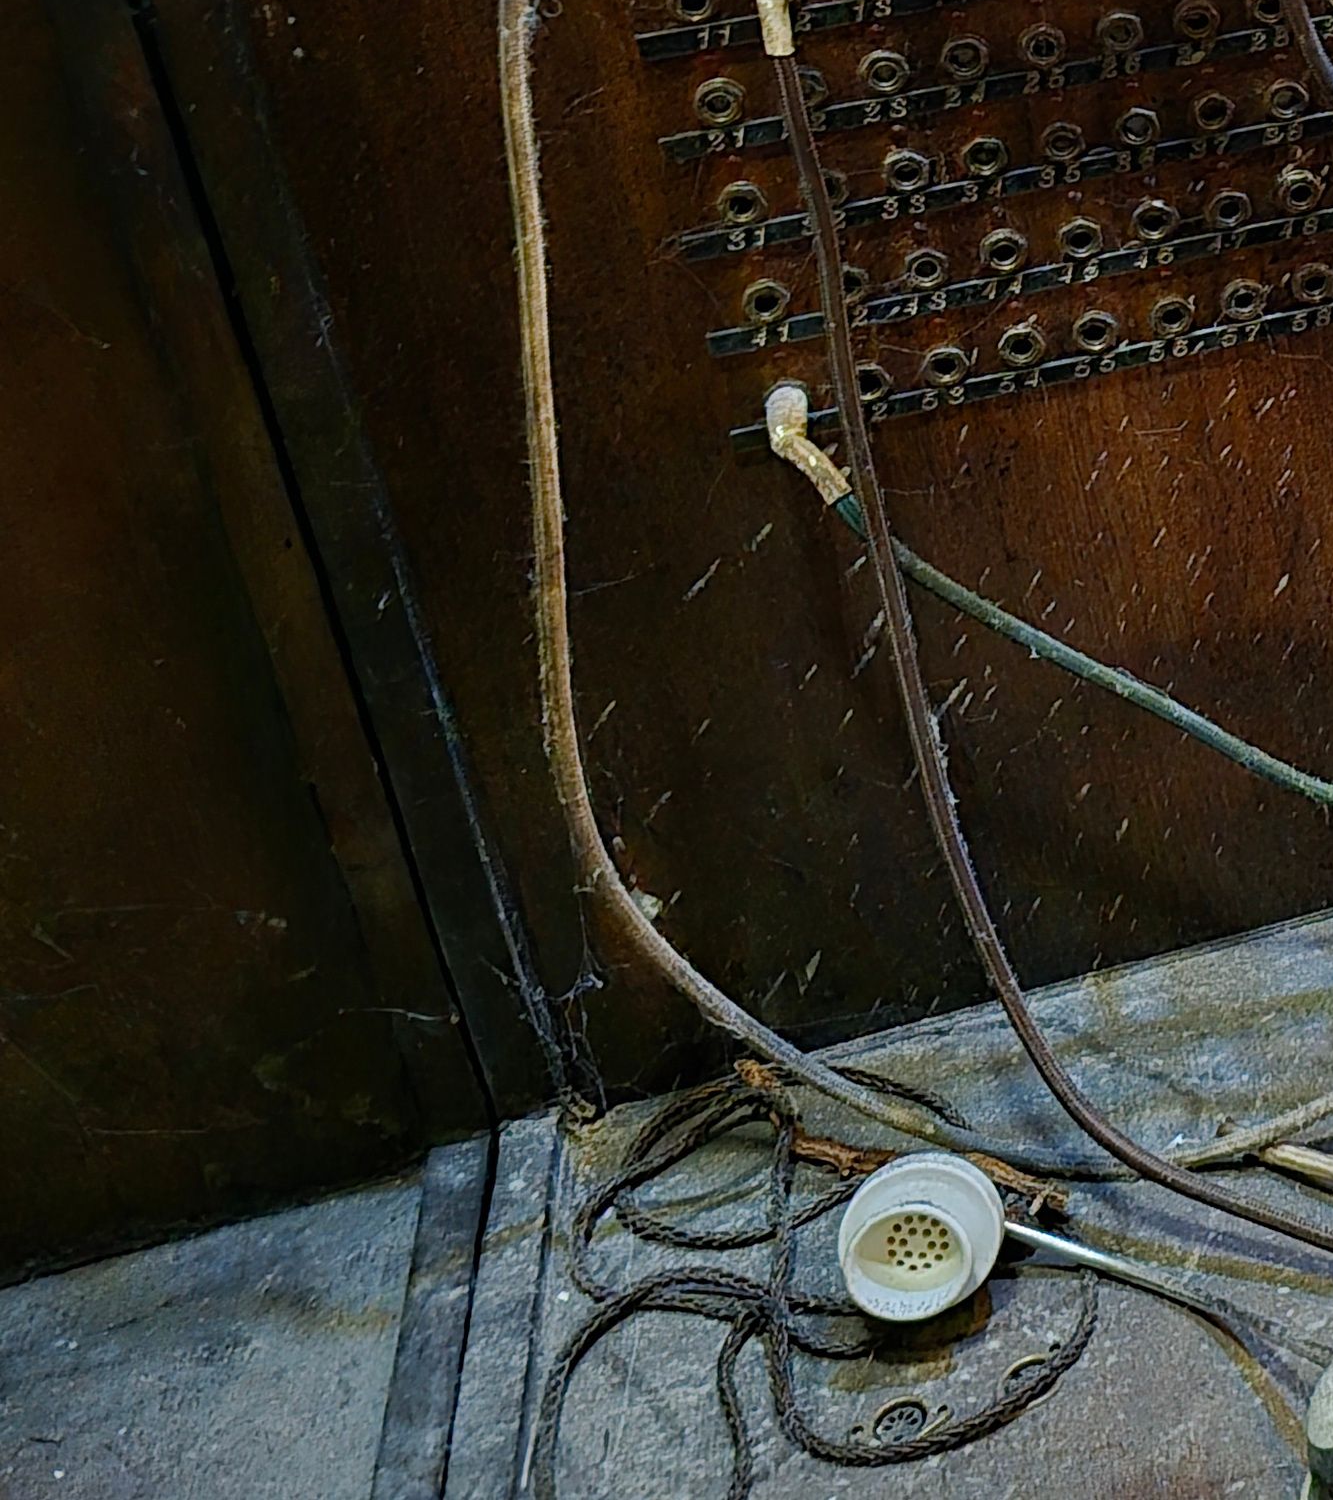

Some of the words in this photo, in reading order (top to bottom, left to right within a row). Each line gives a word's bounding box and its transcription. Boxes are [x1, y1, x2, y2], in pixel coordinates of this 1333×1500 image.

[697, 25, 730, 49] 11
[708, 126, 745, 153] 21
[1023, 67, 1065, 94] 25
[1251, 30, 1289, 54] 28
[1074, 355, 1116, 379] 55
[1221, 325, 1262, 347] 57
[1292, 308, 1331, 332] 58
